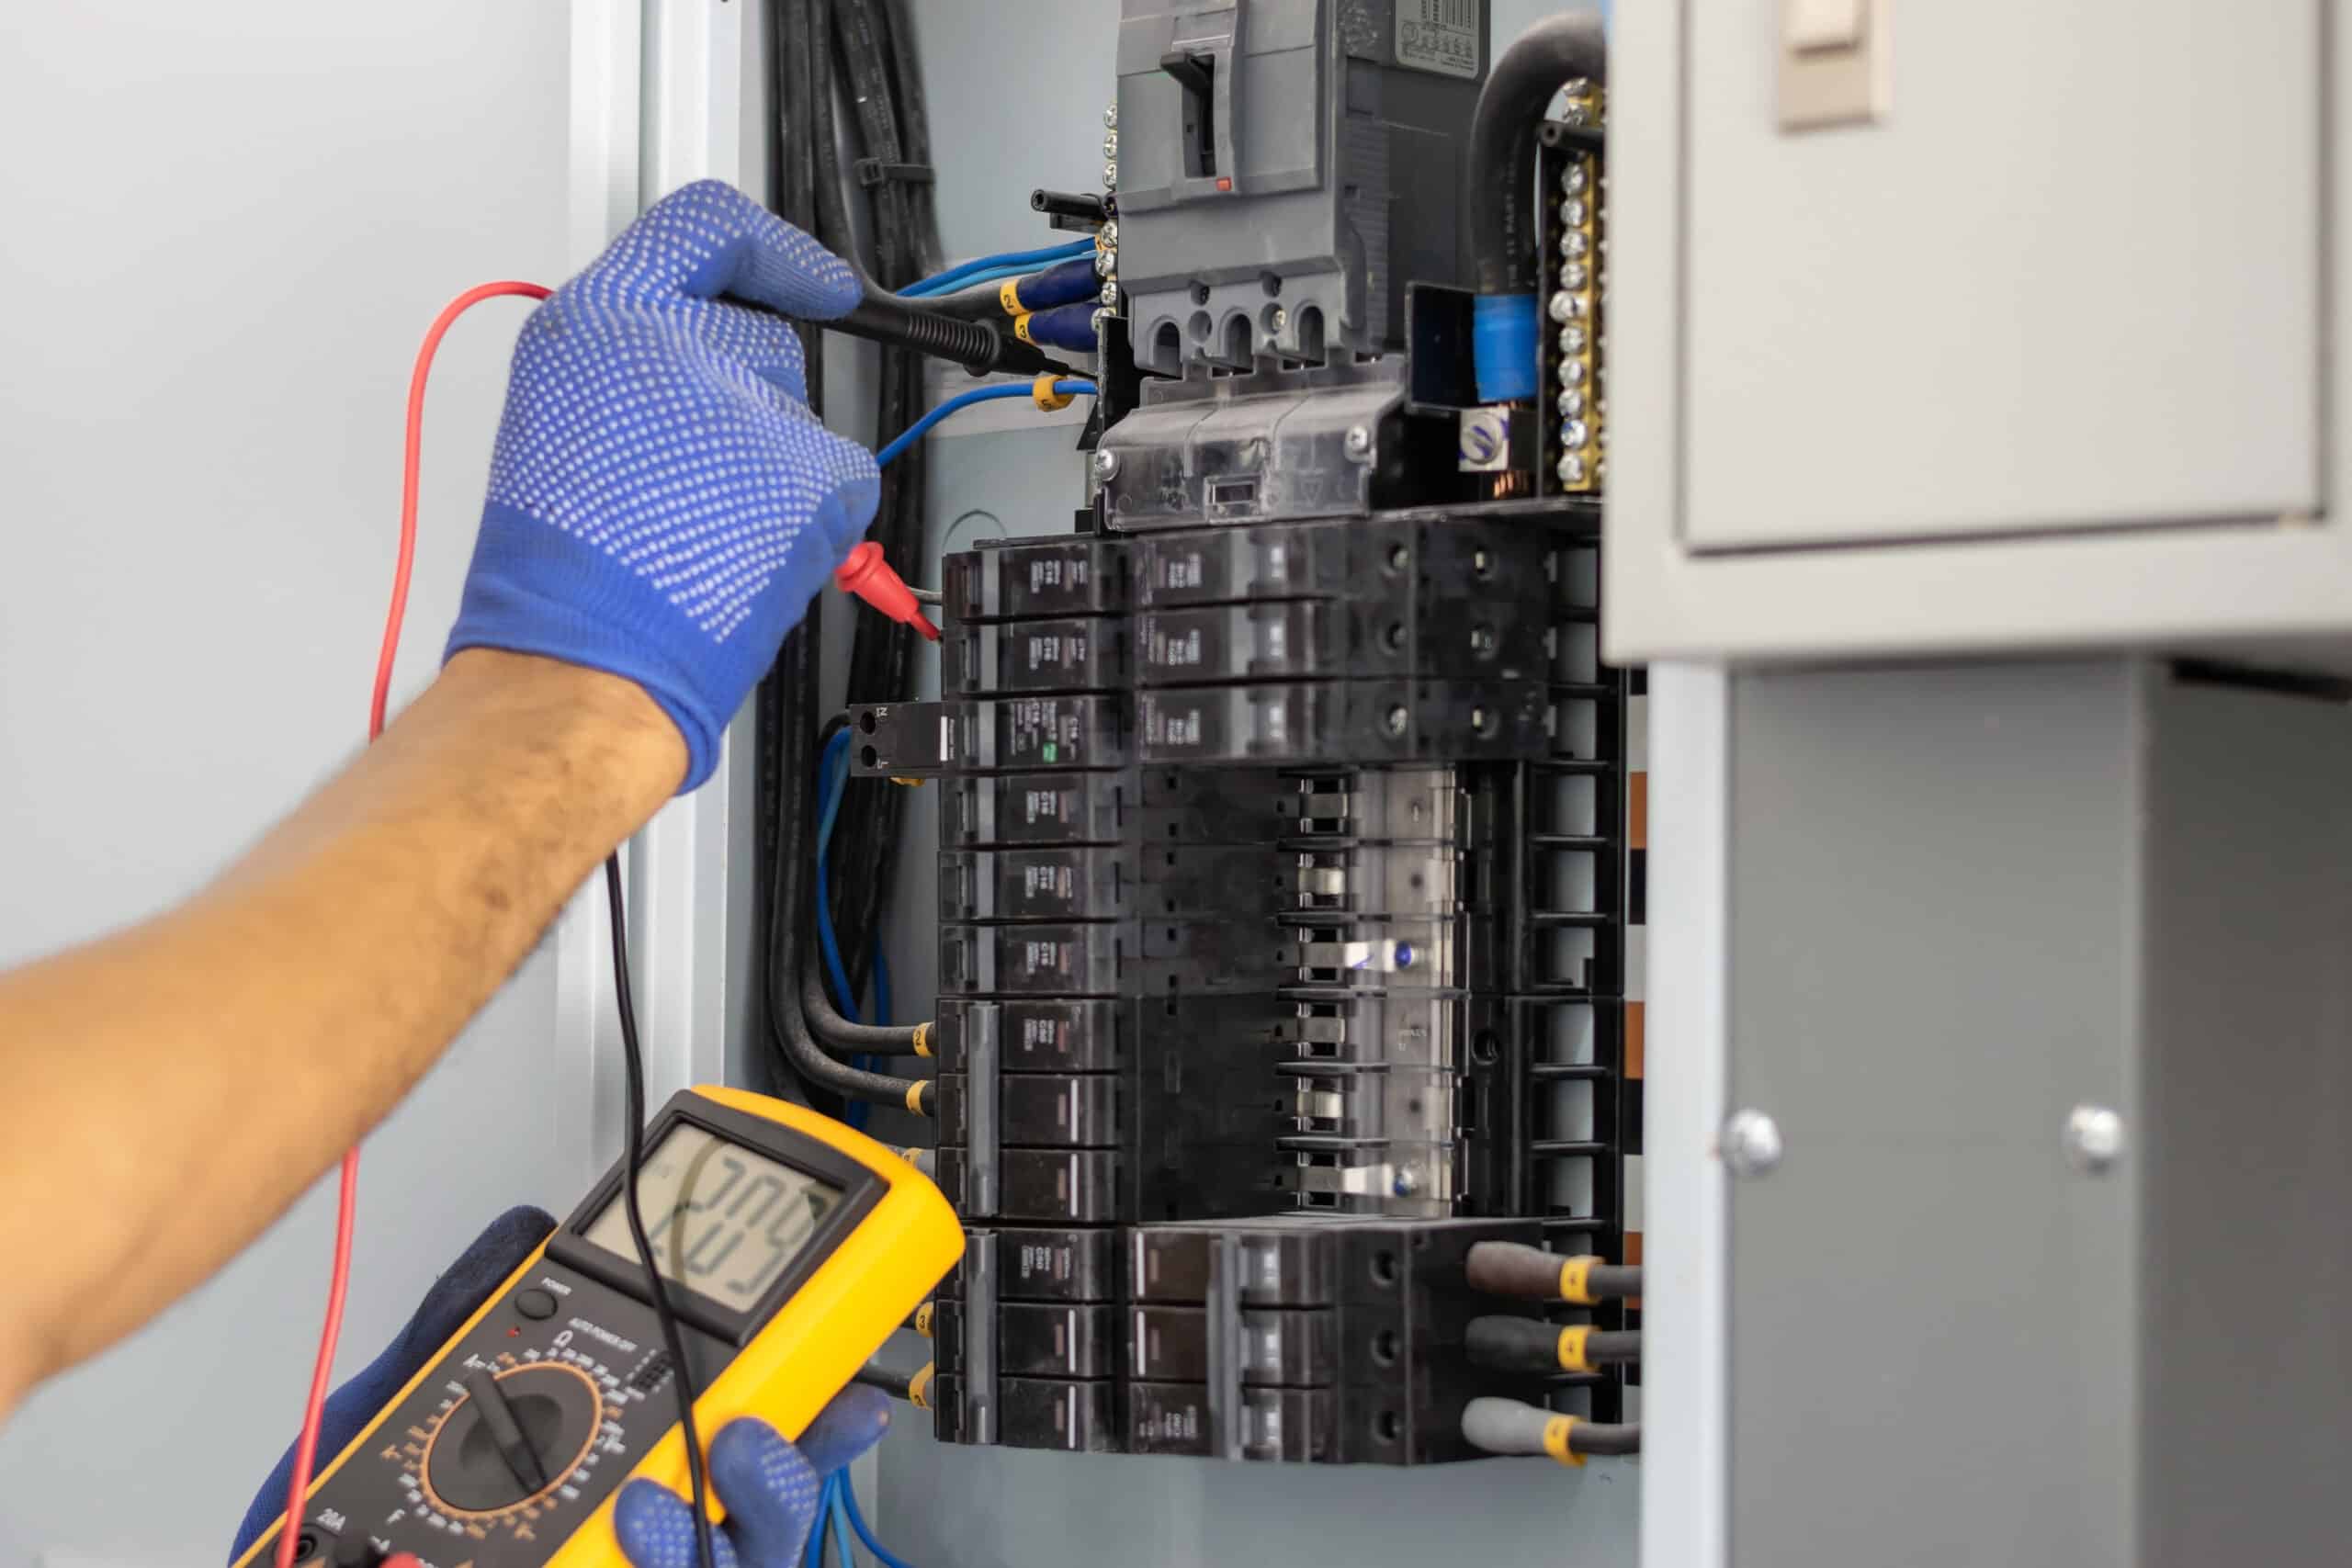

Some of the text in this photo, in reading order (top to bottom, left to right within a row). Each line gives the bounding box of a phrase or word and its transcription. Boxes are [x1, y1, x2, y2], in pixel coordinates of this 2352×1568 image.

[1002, 294, 1014, 309] 2
[1019, 324, 1027, 338] 3
[915, 1030, 922, 1046] 2
[541, 1277, 571, 1295] POWER
[919, 1314, 926, 1329] 3
[568, 1317, 594, 1333] AUTO
[592, 1325, 621, 1345] POWER
